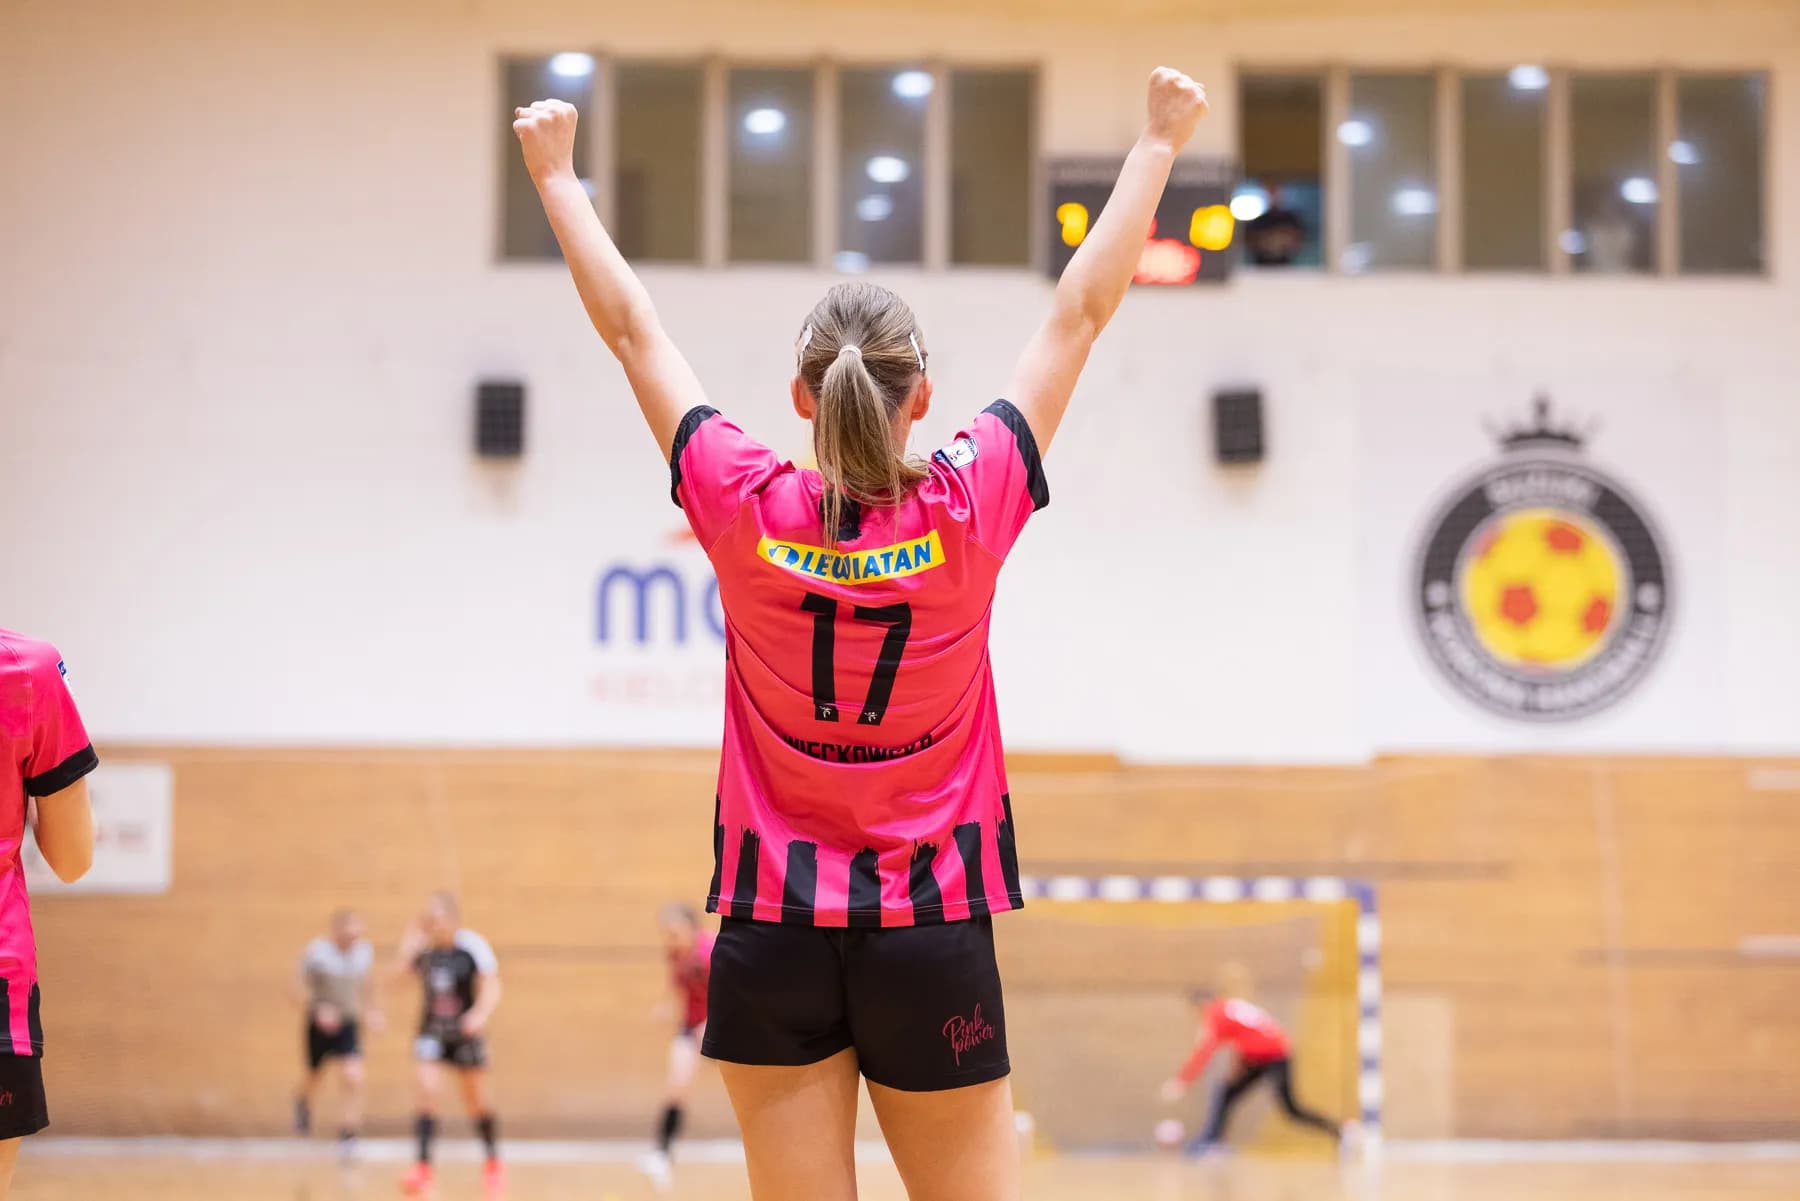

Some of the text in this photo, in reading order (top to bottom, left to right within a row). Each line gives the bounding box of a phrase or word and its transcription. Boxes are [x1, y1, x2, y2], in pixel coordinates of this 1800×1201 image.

[800, 540, 931, 580] LEWIATAN
[800, 591, 912, 726] 17
[942, 1002, 985, 1049] Pink
